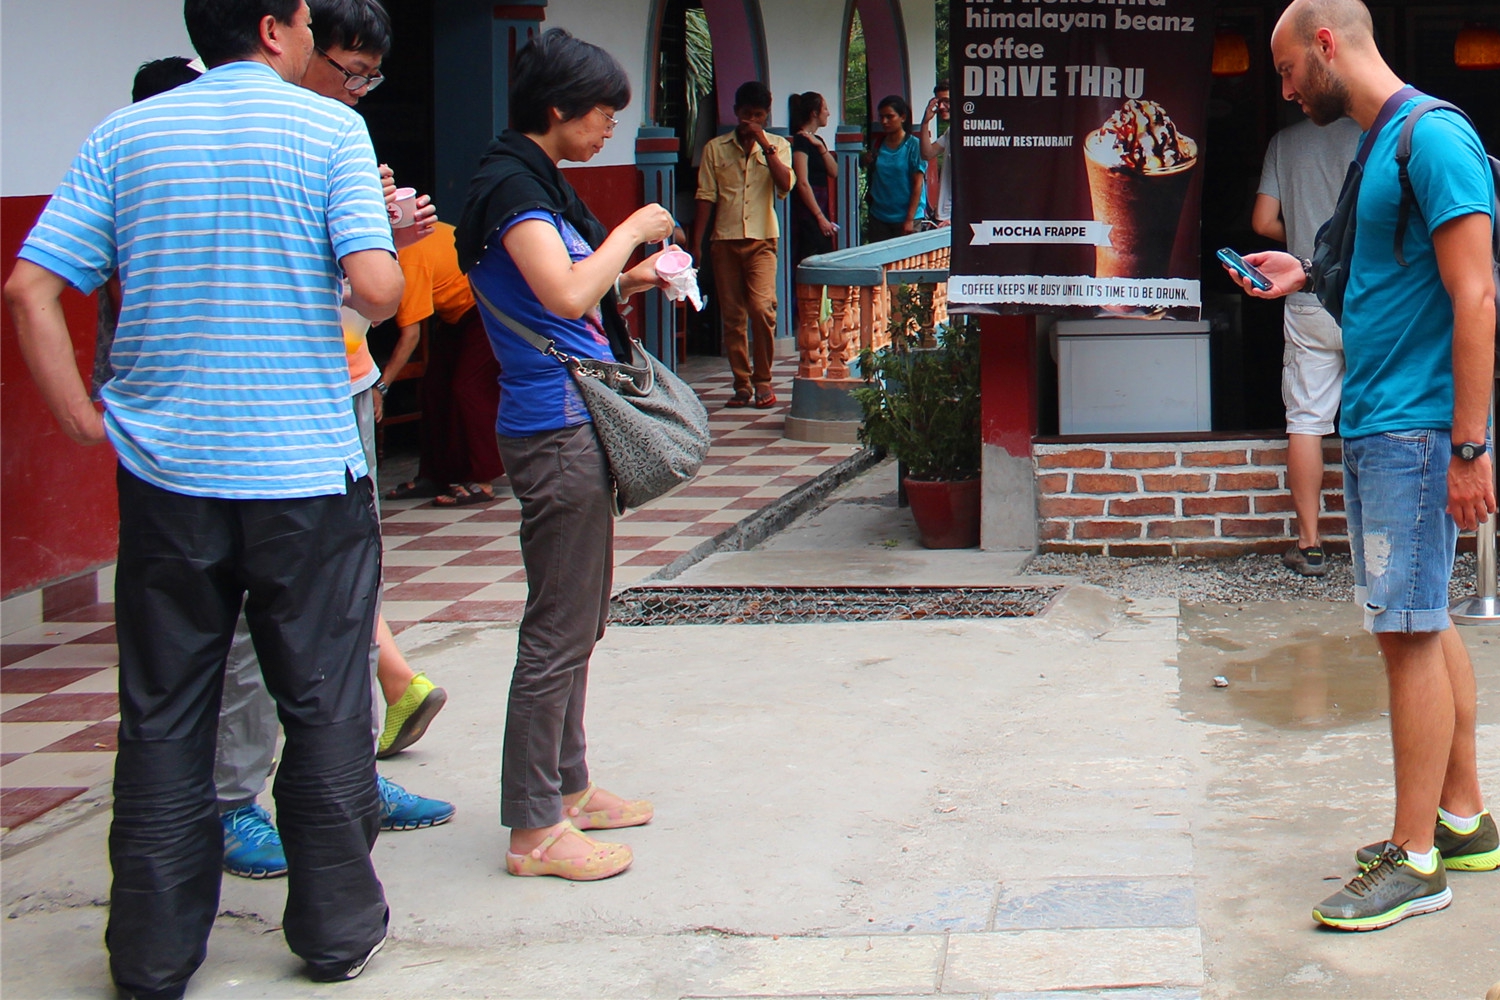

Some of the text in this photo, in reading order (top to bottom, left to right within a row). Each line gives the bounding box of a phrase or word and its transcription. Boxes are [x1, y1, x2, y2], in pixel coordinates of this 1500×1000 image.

[966, 7, 1194, 32] himalayan beanz
[965, 37, 1044, 59] coffee
[964, 65, 1145, 99] DRIVE THRU
[963, 101, 975, 115] @
[963, 119, 1005, 131] GUNADI,
[963, 135, 1074, 147] HIGHWAY RESTAURANT
[993, 226, 1086, 237] MOCHA FRAPPE
[961, 283, 1189, 300] COFFEE KEEPS ME BUSY UNTIL IT'S TIME TO BE DRUNK.
